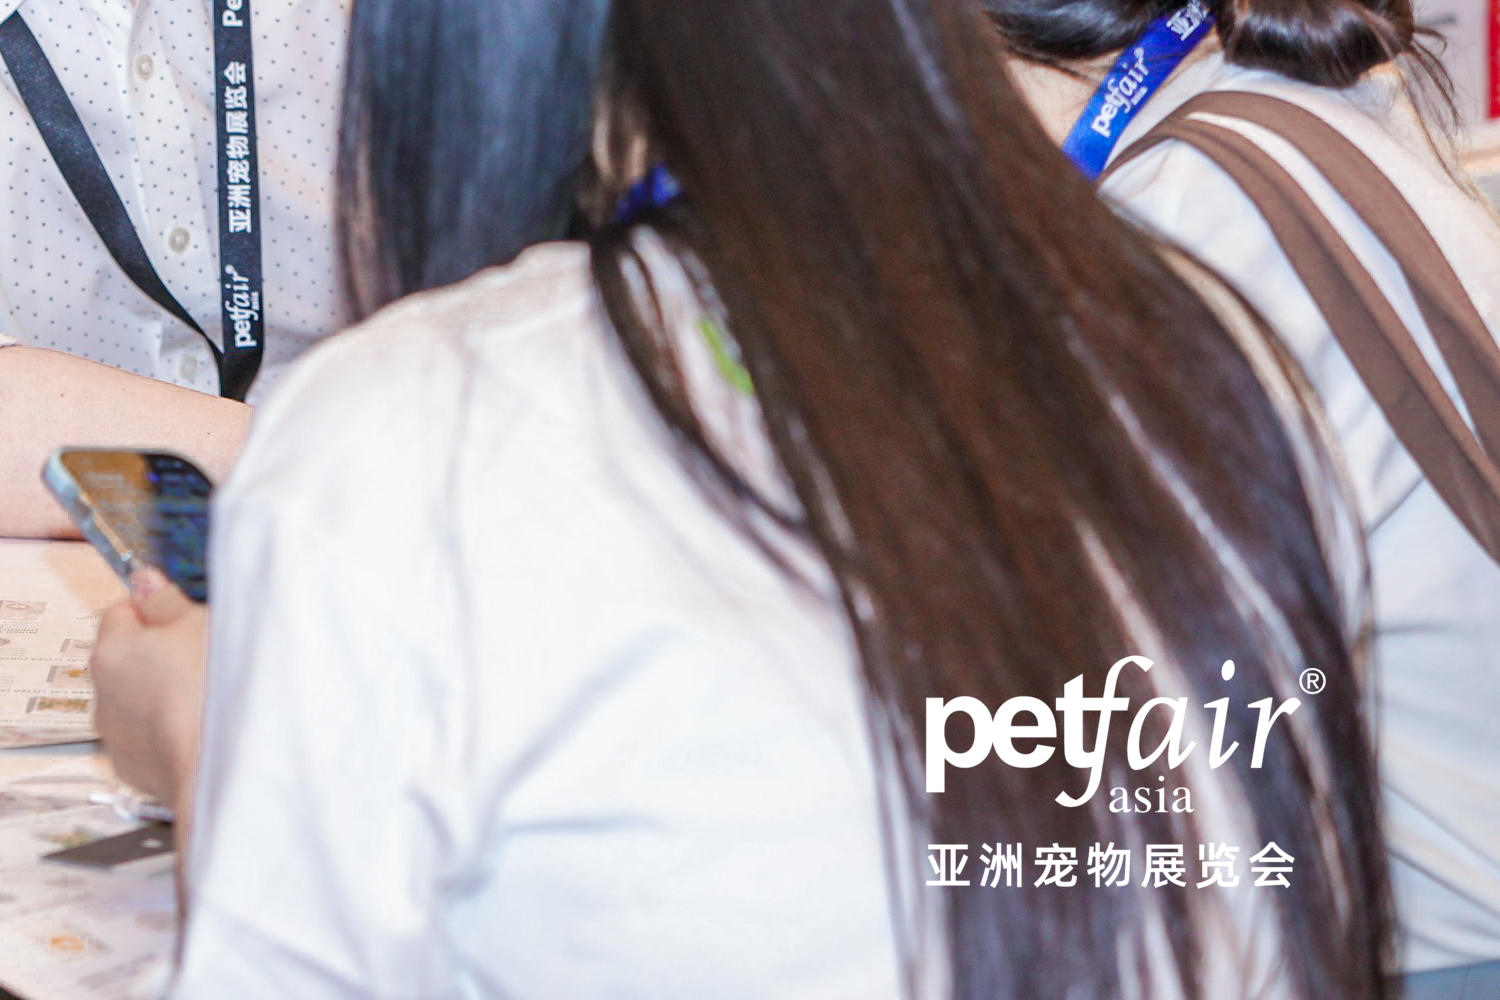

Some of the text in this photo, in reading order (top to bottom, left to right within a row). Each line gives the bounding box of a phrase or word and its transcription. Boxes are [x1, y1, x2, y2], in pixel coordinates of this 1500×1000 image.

[223, 61, 251, 233] 亚洲宠物展览会
